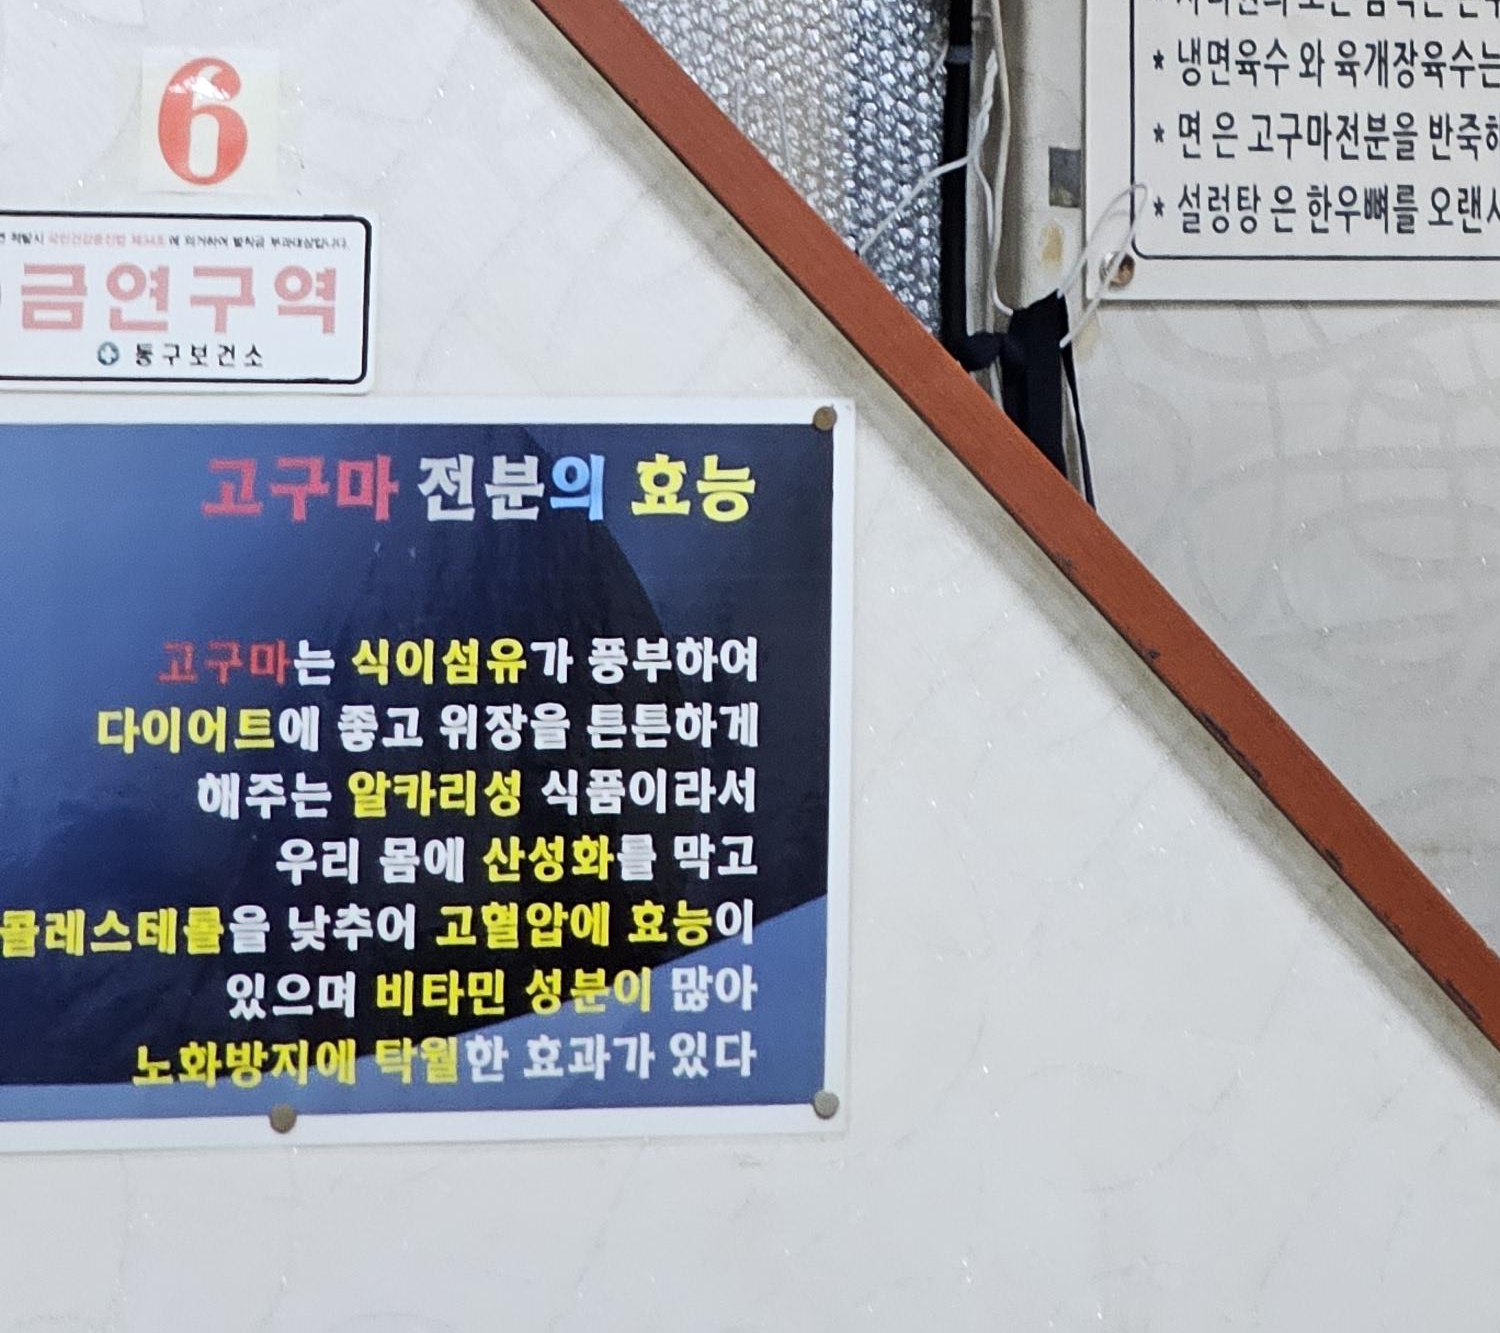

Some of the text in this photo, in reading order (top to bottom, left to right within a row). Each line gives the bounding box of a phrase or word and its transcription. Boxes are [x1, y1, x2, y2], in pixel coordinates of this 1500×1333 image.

[1178, 37, 1289, 87] 냉면육수
[1299, 39, 1325, 87] 와
[158, 57, 248, 186] 6
[1179, 111, 1201, 159] 면
[1212, 112, 1238, 158] 은
[1248, 112, 1418, 161] 고구마전분을
[1178, 183, 1261, 234] 설렁탕
[1270, 186, 1296, 233] 은
[1307, 184, 1418, 234] 한우뼈를
[21, 263, 336, 335] 금연구역
[136, 344, 261, 366] 동구보건소
[203, 453, 757, 523] 고구마 전분의 효능
[159, 638, 759, 687] 고구마는 식이섬유가 풍부하여
[97, 702, 759, 755] 다이어트에 좋고 위장을 튼튼하게
[198, 769, 757, 820] 해주는 알카리성 식품이라서
[276, 833, 758, 885] 우리 몸에 산성화를 막고
[0, 898, 754, 959] 콜레스테롤을 낮추어 고혈압에 효능이
[226, 966, 757, 1021] 있으며 비타민 성분이 많아
[132, 1031, 757, 1088] 노화방지에 탁월한 효과가 있다
